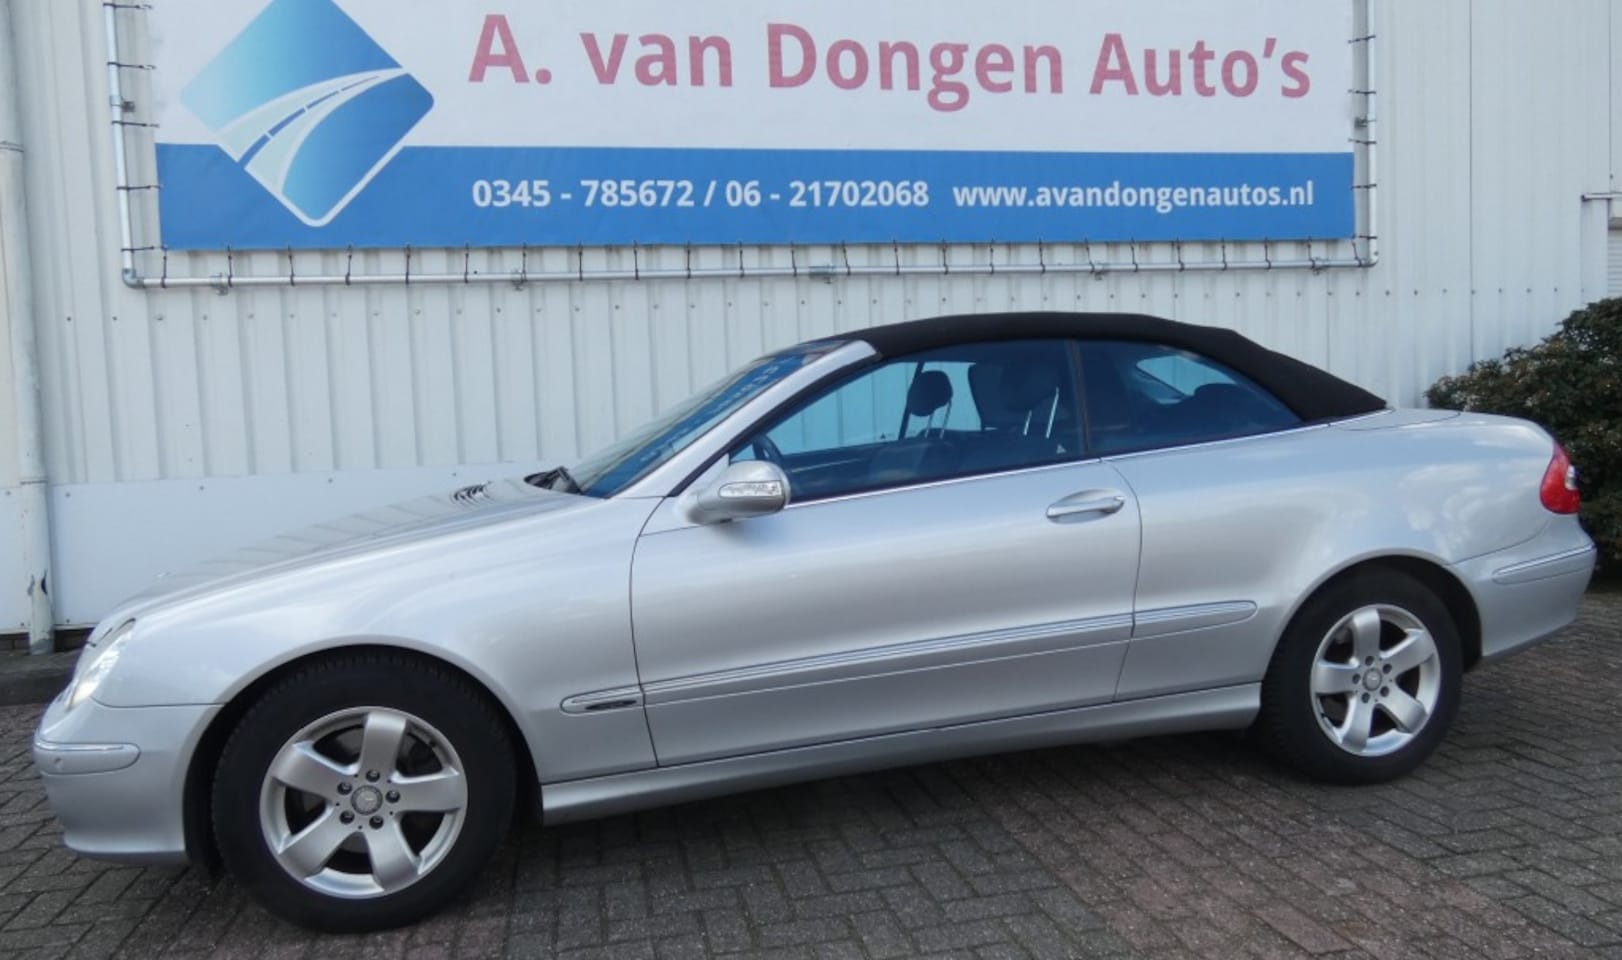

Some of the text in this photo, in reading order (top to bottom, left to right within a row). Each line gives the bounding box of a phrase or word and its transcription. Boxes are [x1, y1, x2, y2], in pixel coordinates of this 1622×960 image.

[468, 14, 1311, 112] A. van Dongen Auto’s
[472, 180, 551, 208] 0345
[580, 179, 695, 208] 785672
[703, 180, 717, 208] /
[725, 180, 762, 208] 06
[789, 180, 930, 208] 21702068
[952, 180, 1314, 214] www.avandongenautos.nl
